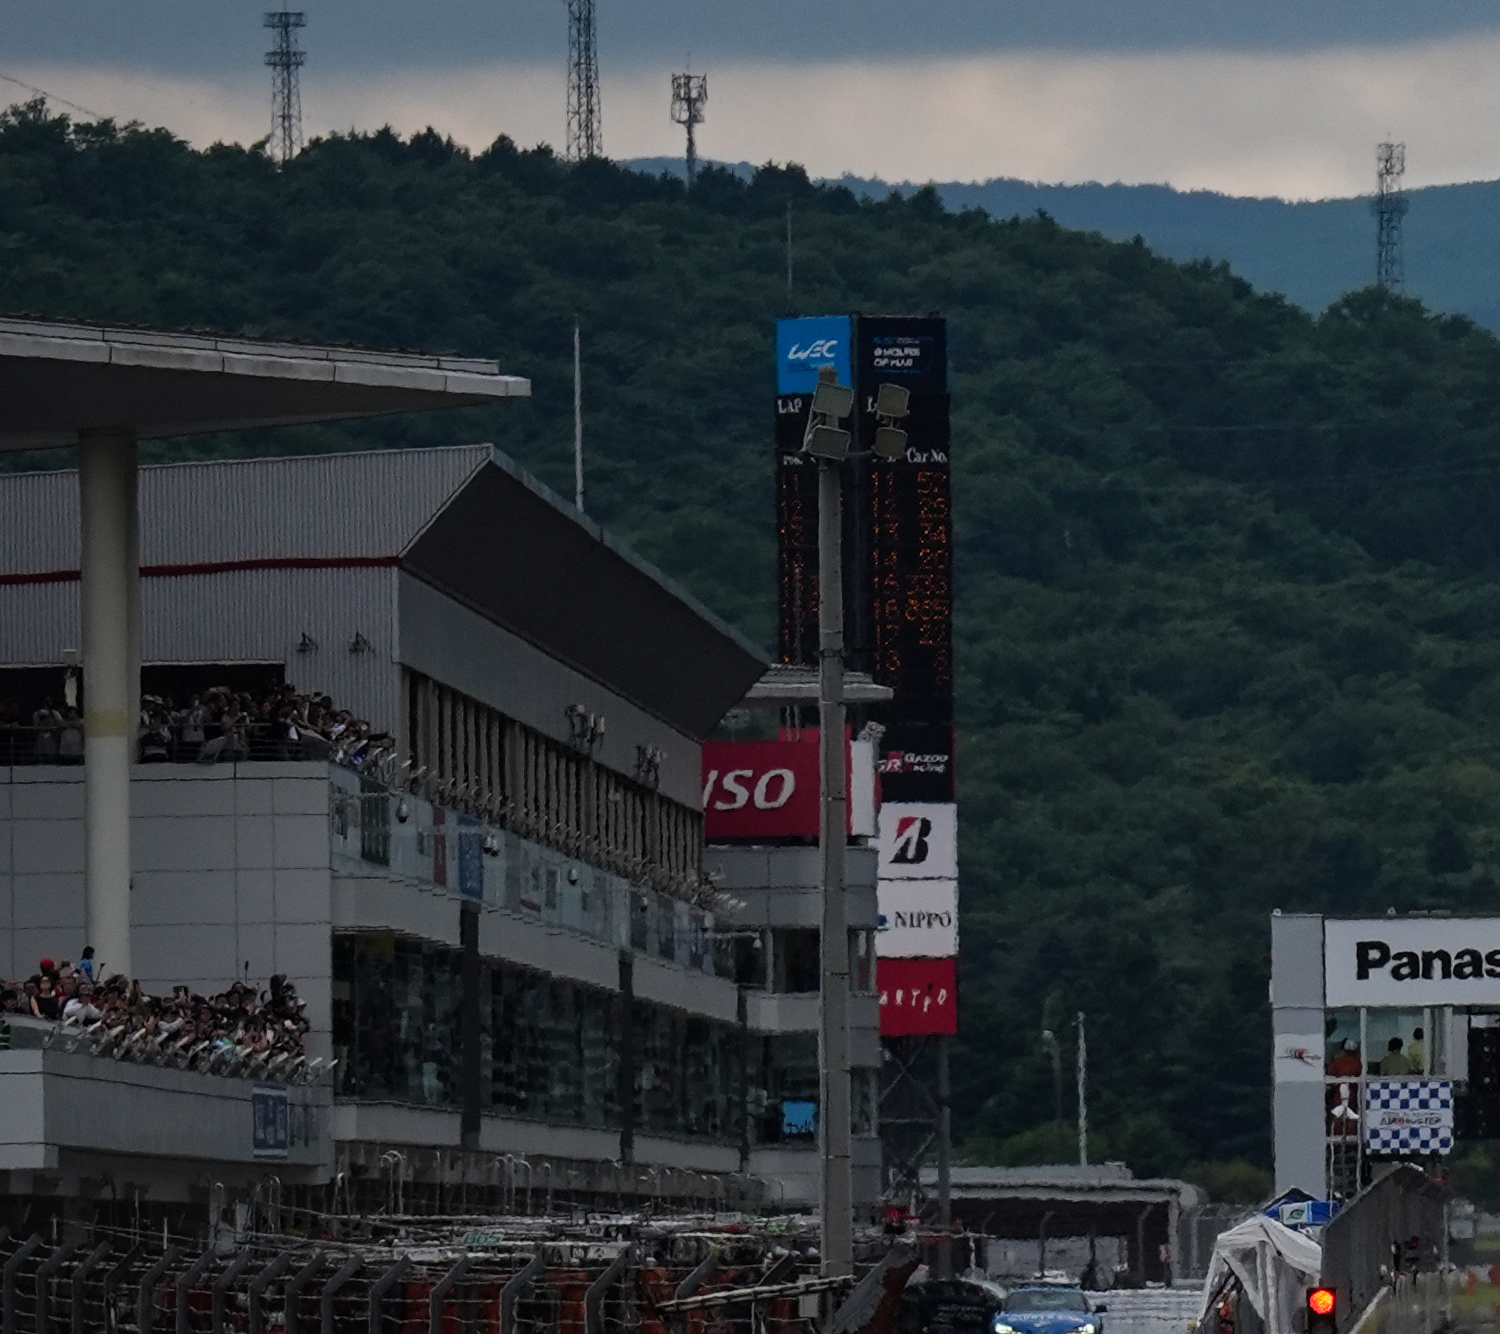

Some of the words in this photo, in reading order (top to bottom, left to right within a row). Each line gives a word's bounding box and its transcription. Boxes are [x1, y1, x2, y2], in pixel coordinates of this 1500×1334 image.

[777, 397, 802, 414] LAP
[906, 446, 931, 463] Car
[904, 752, 949, 764] GAZOO
[894, 911, 952, 928] NIPPO
